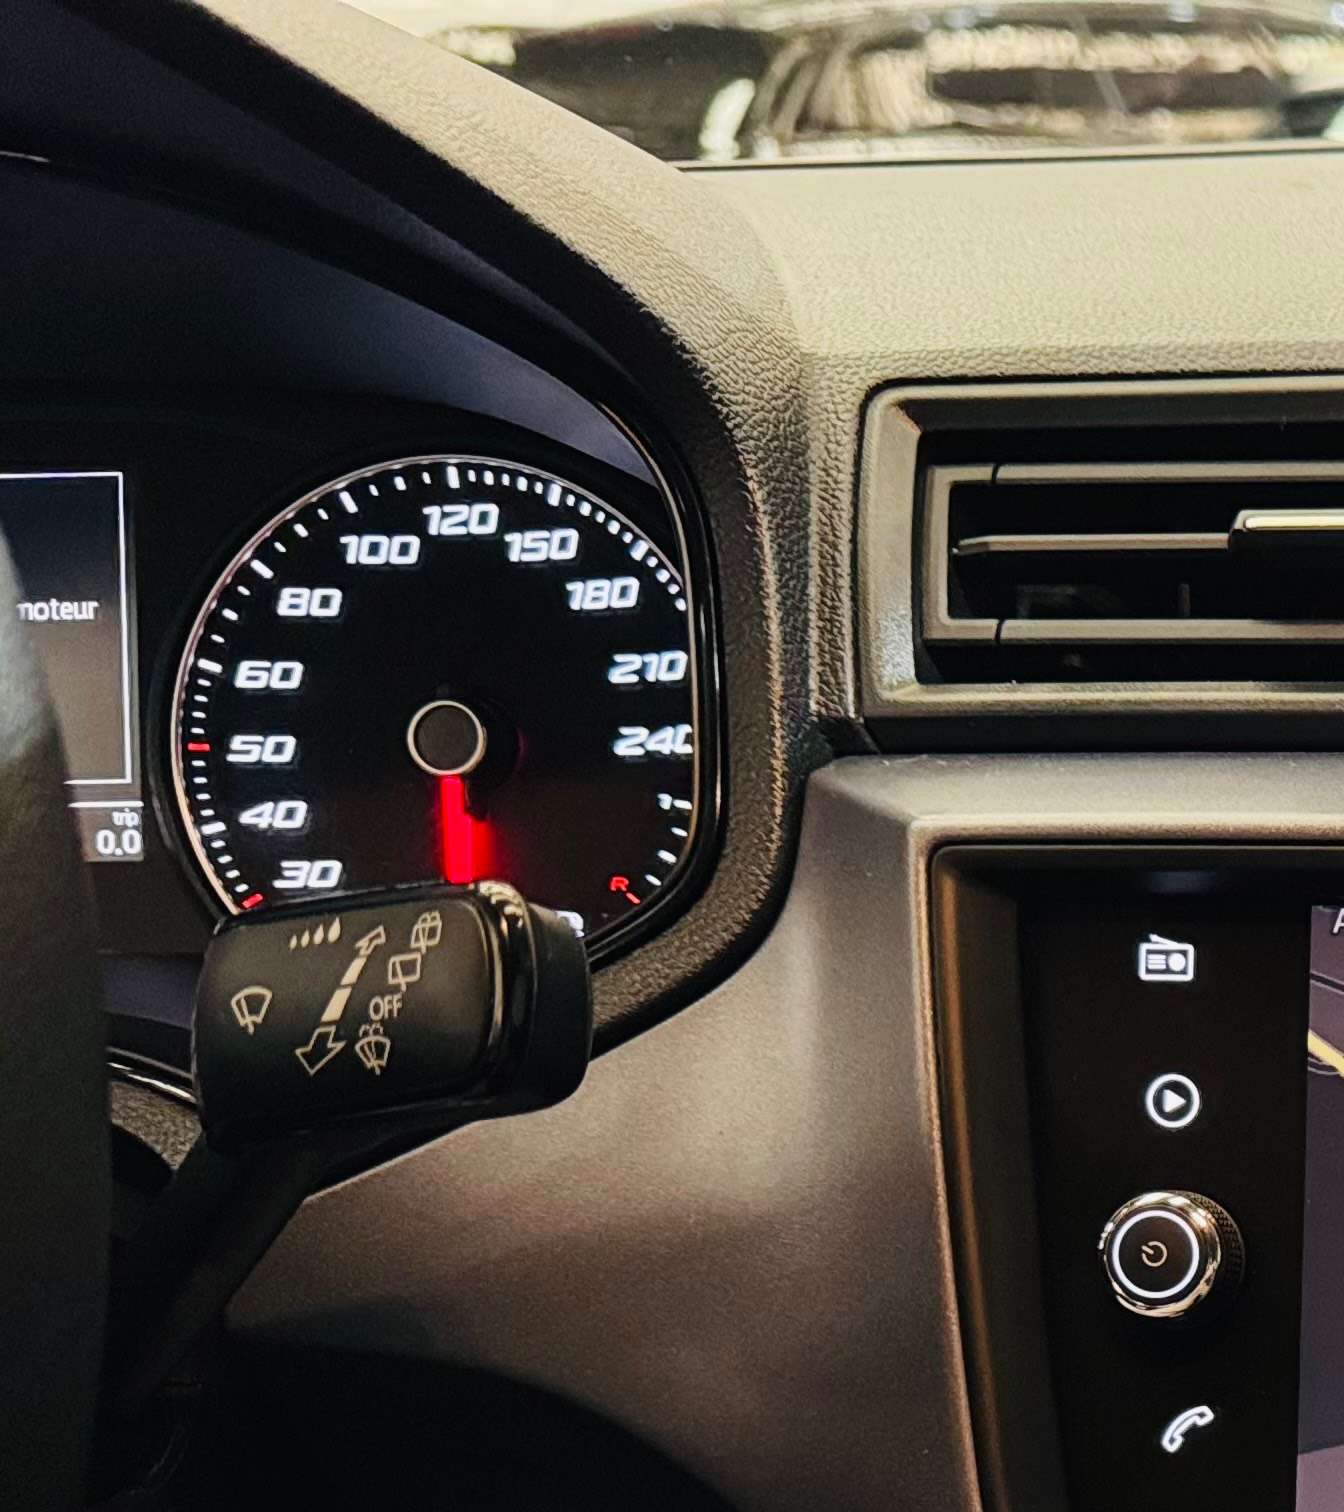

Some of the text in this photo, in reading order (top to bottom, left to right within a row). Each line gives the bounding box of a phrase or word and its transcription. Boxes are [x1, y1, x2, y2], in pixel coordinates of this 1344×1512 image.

[421, 503, 499, 537] 120
[340, 534, 421, 566] 100
[504, 528, 579, 563] 150
[276, 587, 342, 618] 80
[565, 577, 639, 611] 180
[233, 660, 303, 691] 60
[607, 651, 688, 684] 210
[226, 734, 297, 764] 50
[112, 807, 141, 828] trip
[239, 800, 307, 830] 40
[95, 829, 142, 855] 0.0
[272, 859, 343, 889] 30
[369, 993, 403, 1021] OFF
